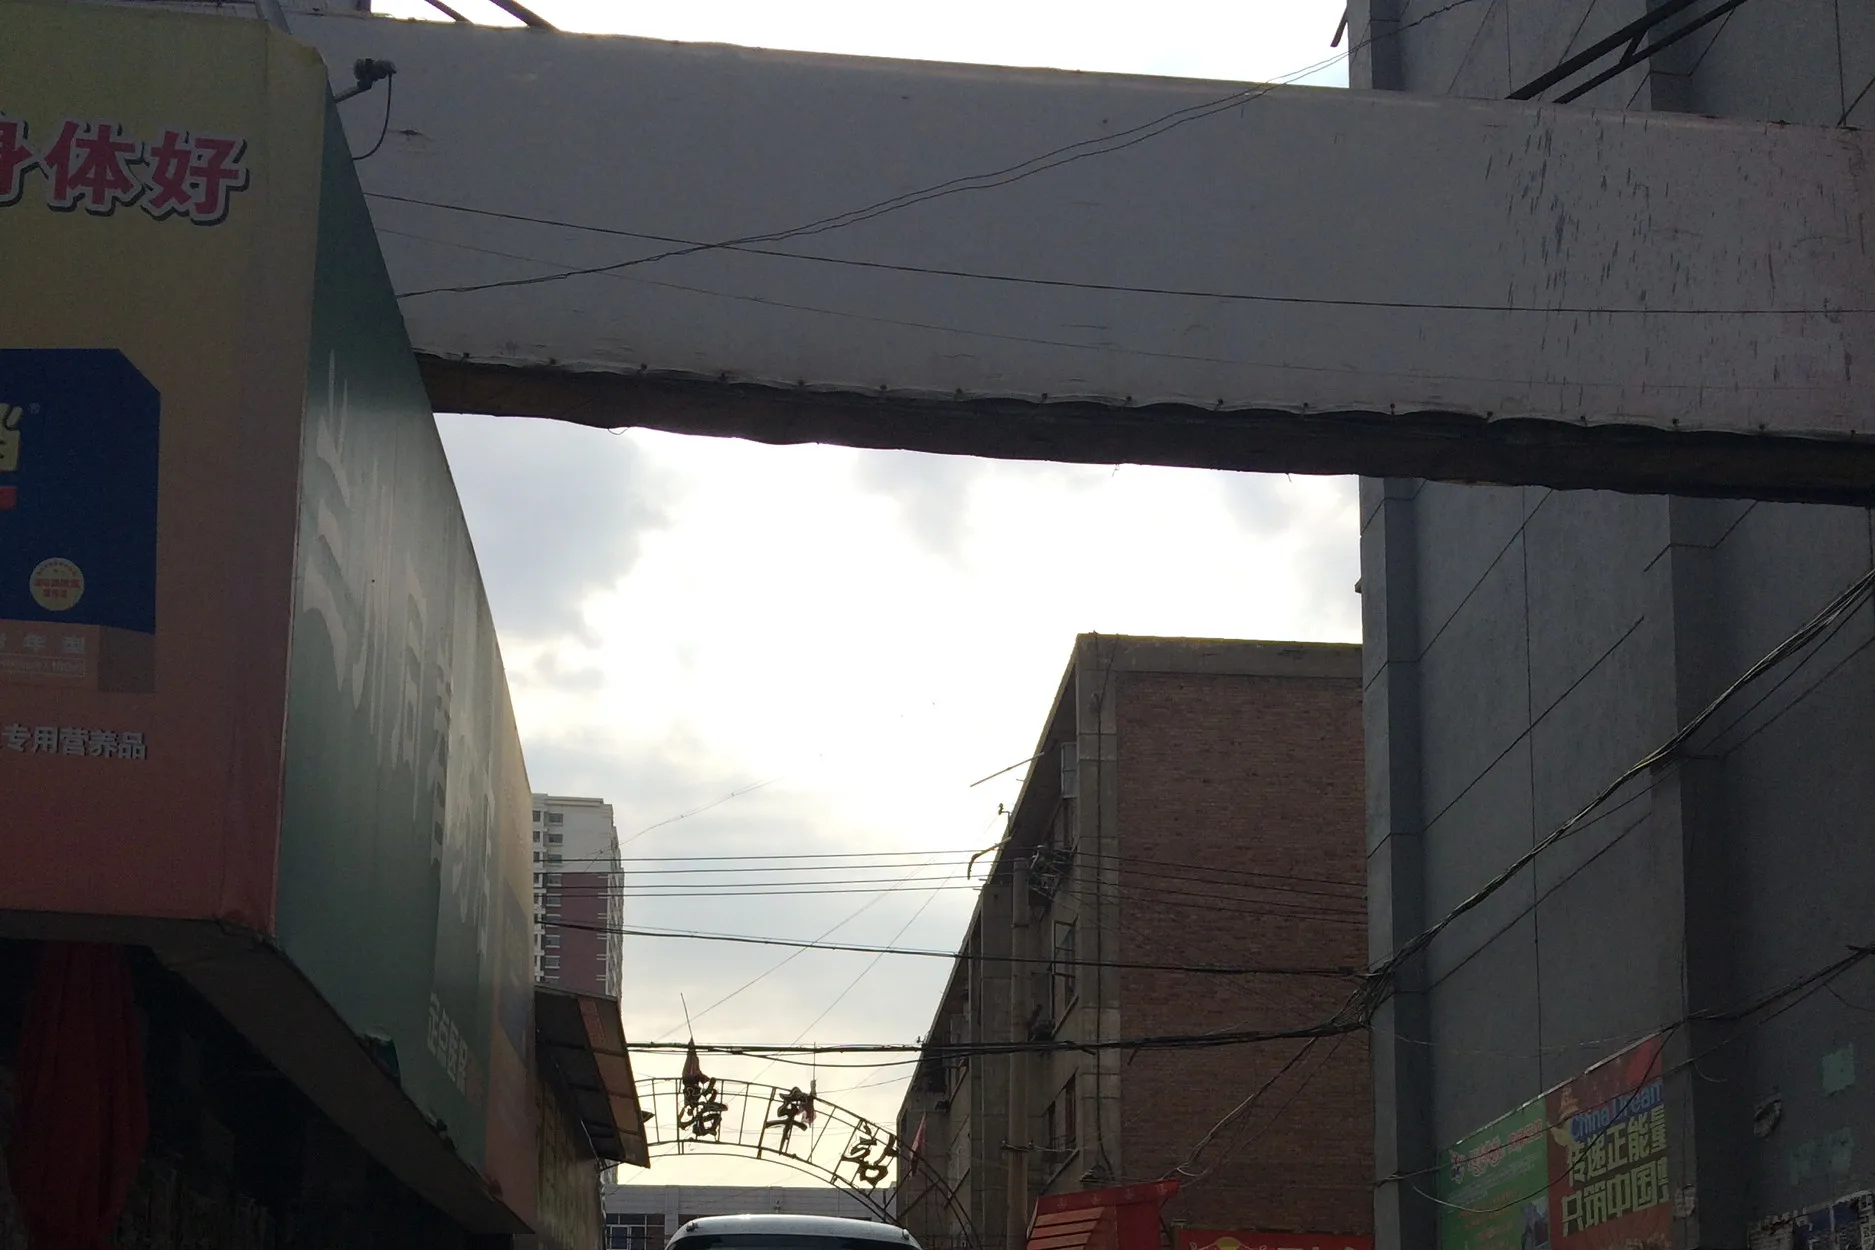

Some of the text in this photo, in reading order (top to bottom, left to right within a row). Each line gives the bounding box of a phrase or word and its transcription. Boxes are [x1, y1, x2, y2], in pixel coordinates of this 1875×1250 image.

[2, 722, 147, 760] 专用营养品
[1570, 1106, 1610, 1140] China
[1568, 1103, 1667, 1187] 传递正能量
